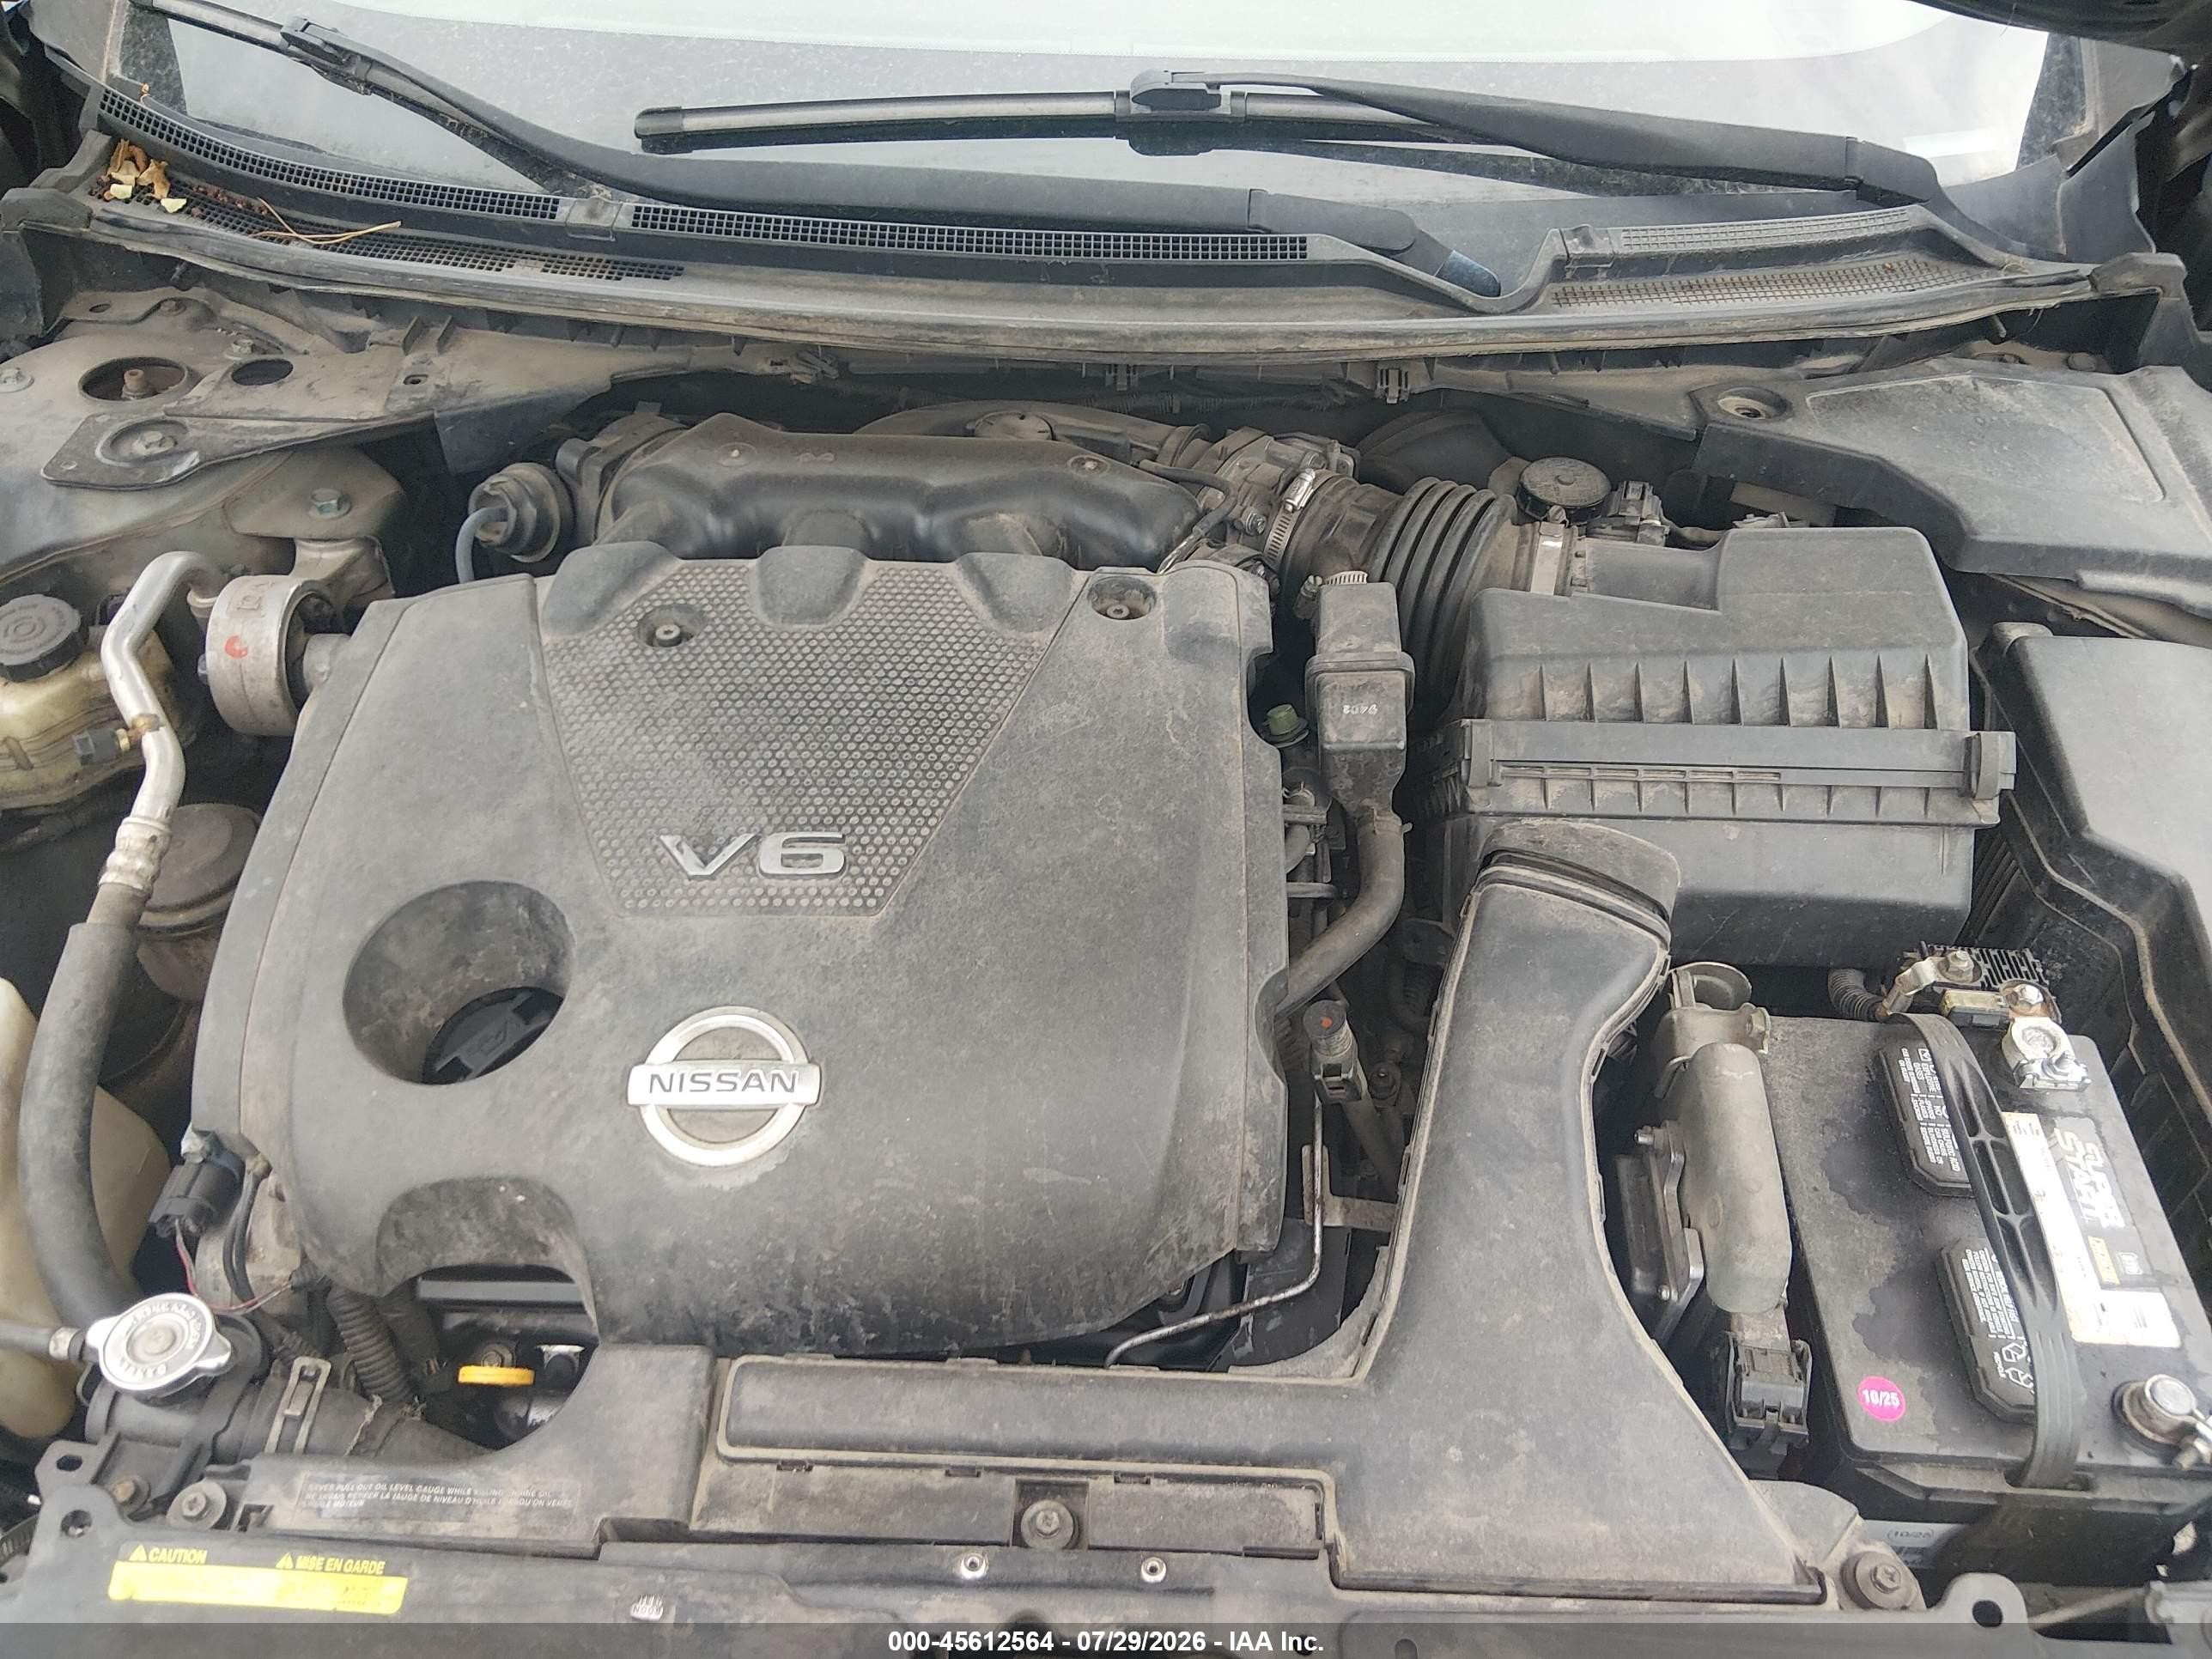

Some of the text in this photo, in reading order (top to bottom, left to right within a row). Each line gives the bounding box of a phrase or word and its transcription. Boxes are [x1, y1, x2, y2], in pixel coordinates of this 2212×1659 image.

[659, 832, 846, 876] V6
[649, 1071, 799, 1092] NISSAN
[1933, 1105, 1942, 1115] NO
[1949, 1158, 1960, 1170] ACID
[2054, 1128, 2100, 1218] START
[1862, 1389, 1899, 1408] 10/25
[149, 1547, 207, 1564] CAUTION
[295, 1556, 386, 1575] MISE EN GARDE
